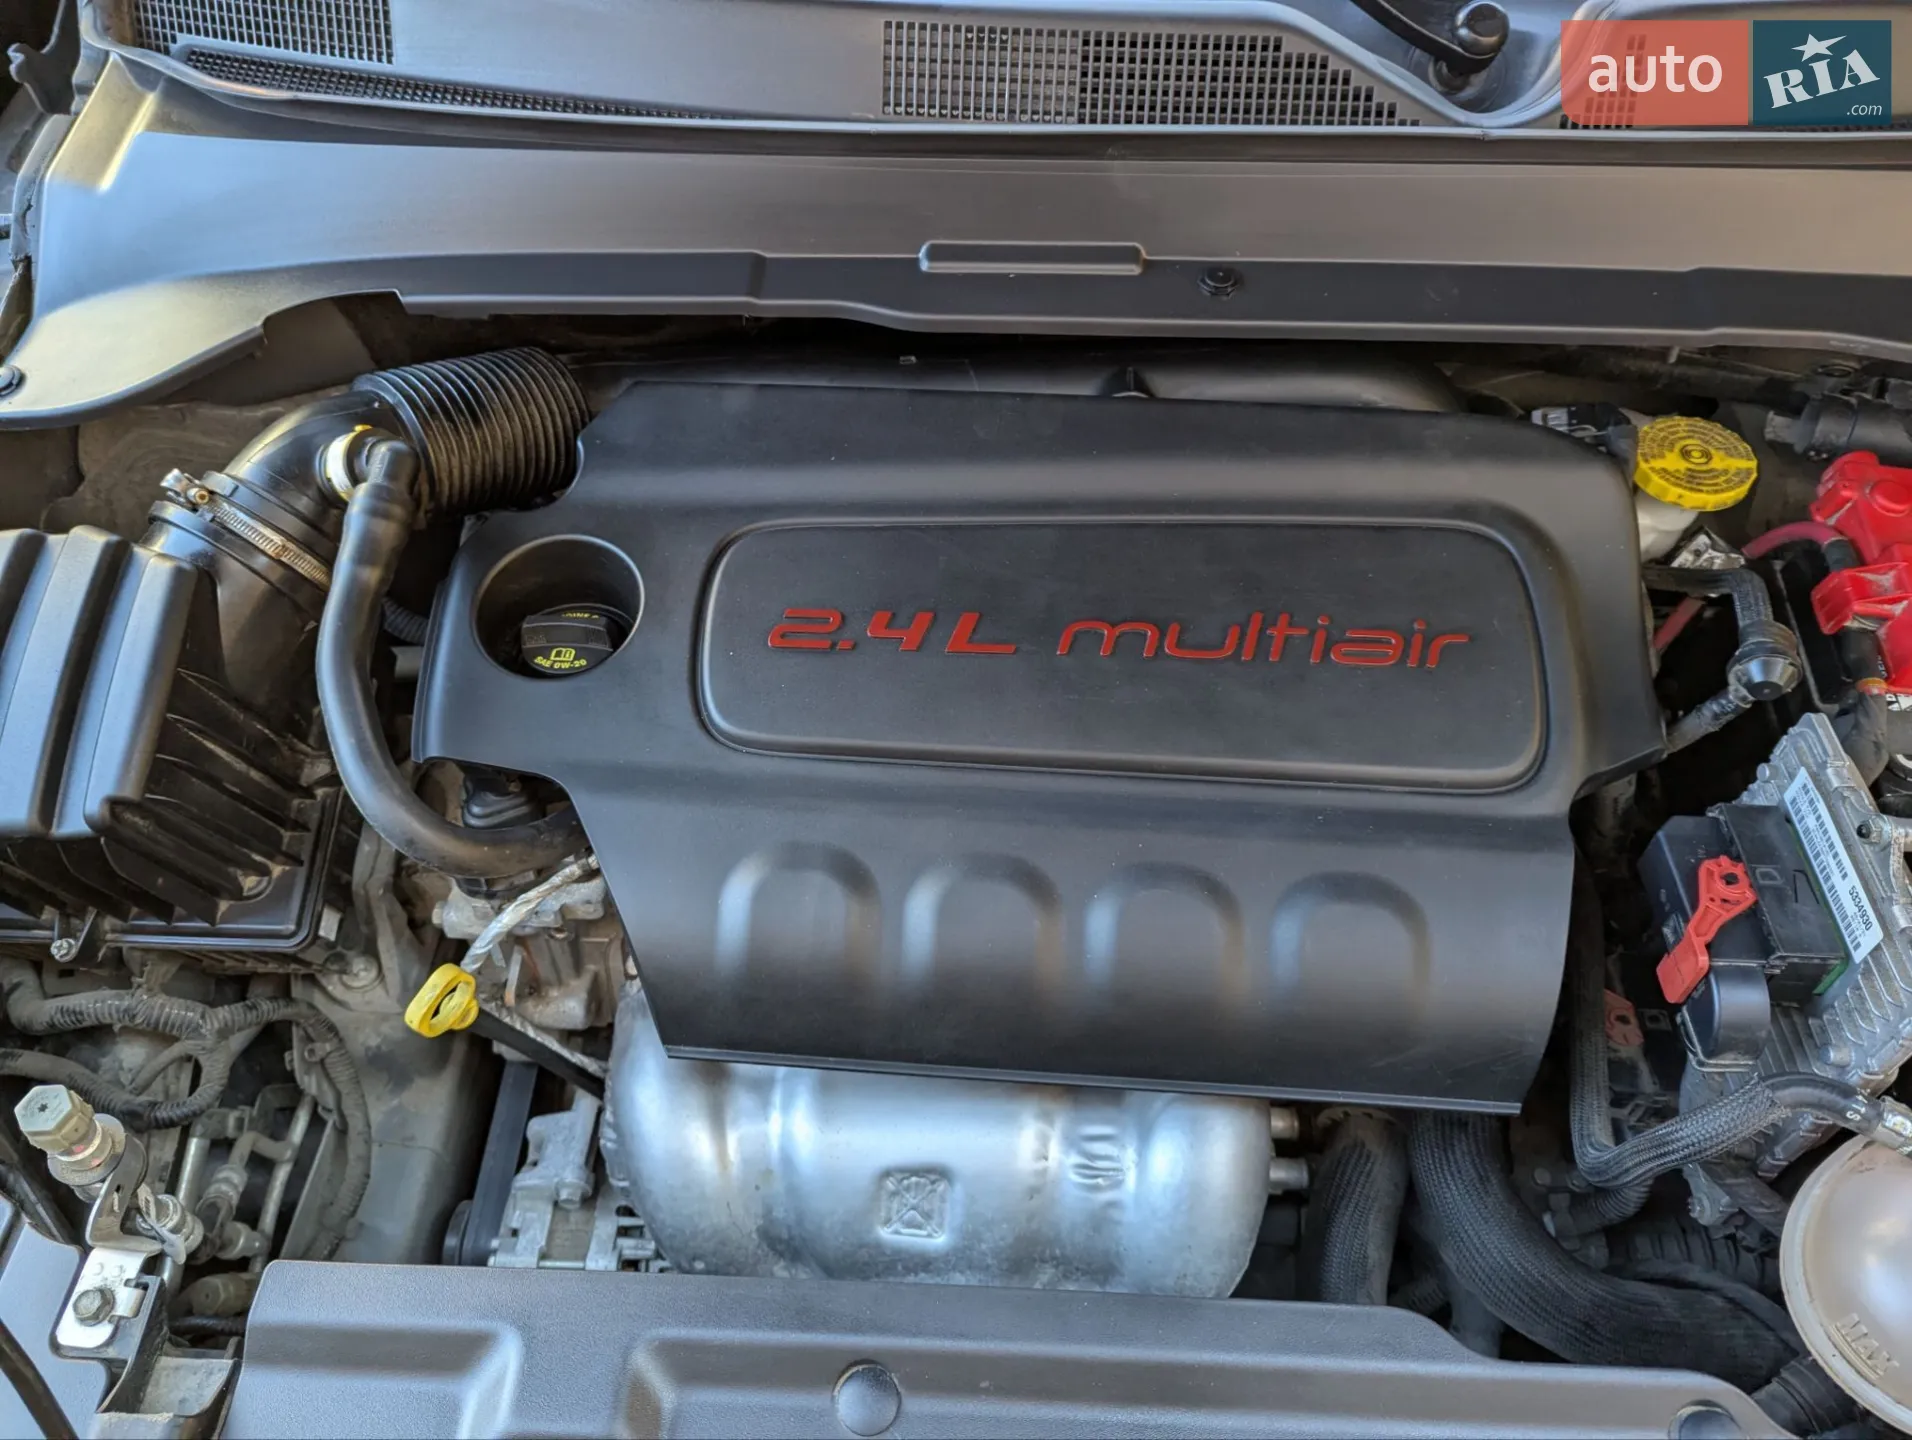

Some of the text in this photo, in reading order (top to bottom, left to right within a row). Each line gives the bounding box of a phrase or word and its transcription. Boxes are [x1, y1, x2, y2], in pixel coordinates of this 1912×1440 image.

[534, 656, 587, 668] SAE 0W-20
[1056, 611, 1470, 667] multiair
[1848, 885, 1873, 931] 5334930
[1835, 1312, 1900, 1376] MAX
